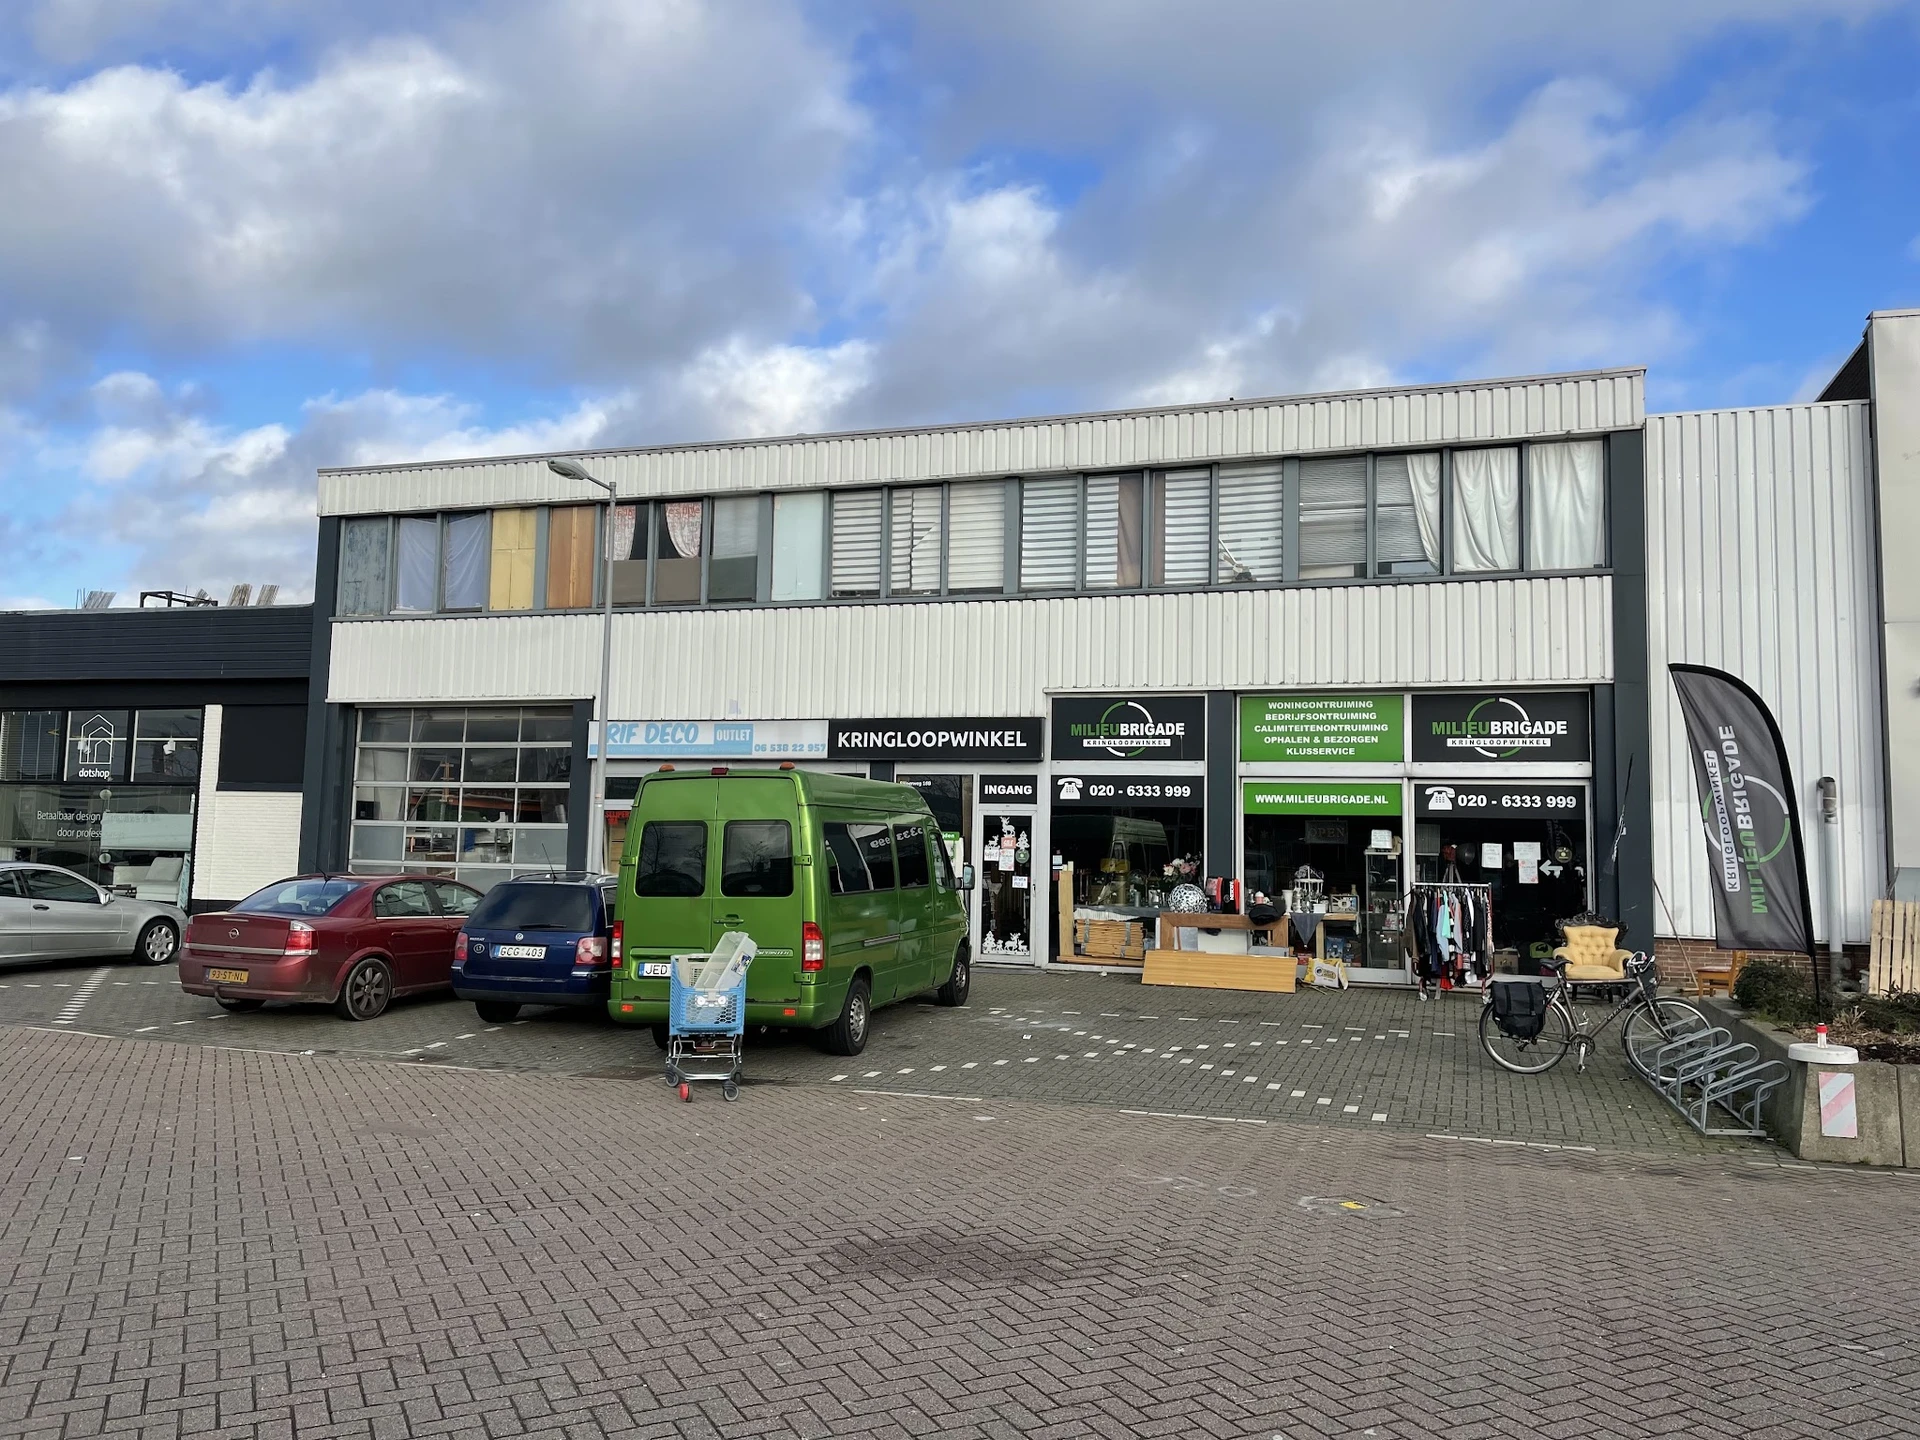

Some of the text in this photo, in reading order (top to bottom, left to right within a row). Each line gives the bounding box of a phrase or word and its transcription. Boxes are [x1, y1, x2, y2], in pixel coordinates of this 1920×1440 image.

[1268, 701, 1373, 709] WONINGONTRUIMING
[1265, 712, 1377, 721] BEDRIJFSONTRUIMING
[644, 722, 699, 744] DECO
[1070, 722, 1185, 736] MILIEUBRIGADE
[1254, 724, 1389, 733] CALIMITEITENONTRUIMING
[1432, 720, 1568, 735] MILIEUBRIGADE
[716, 729, 751, 741] OUTLET
[837, 730, 1027, 748] KRINGLOOPWINKEL
[1264, 736, 1310, 744] OPHALEN
[1324, 735, 1379, 743] BEZORGEN
[754, 743, 827, 752] 06 538 22 957
[1286, 747, 1356, 755] KLUSSERVICE
[79, 768, 110, 779] dotshop
[984, 785, 1033, 795] INGANG
[1089, 785, 1115, 796] 020
[1126, 785, 1161, 797] 6333
[1165, 785, 1191, 797] 999
[1255, 794, 1389, 804] WWW.MILIEUBRIGADE.NL
[1457, 794, 1488, 807] 020
[1501, 795, 1542, 808] 6333
[1546, 796, 1577, 808] 999
[37, 811, 74, 820] Betaalbaar
[75, 810, 101, 823] design
[57, 828, 75, 837] door
[1310, 827, 1345, 838] OPEN
[500, 946, 543, 957] GCG 403
[211, 970, 244, 981] 93-ST-NL
[645, 965, 668, 975] JED
